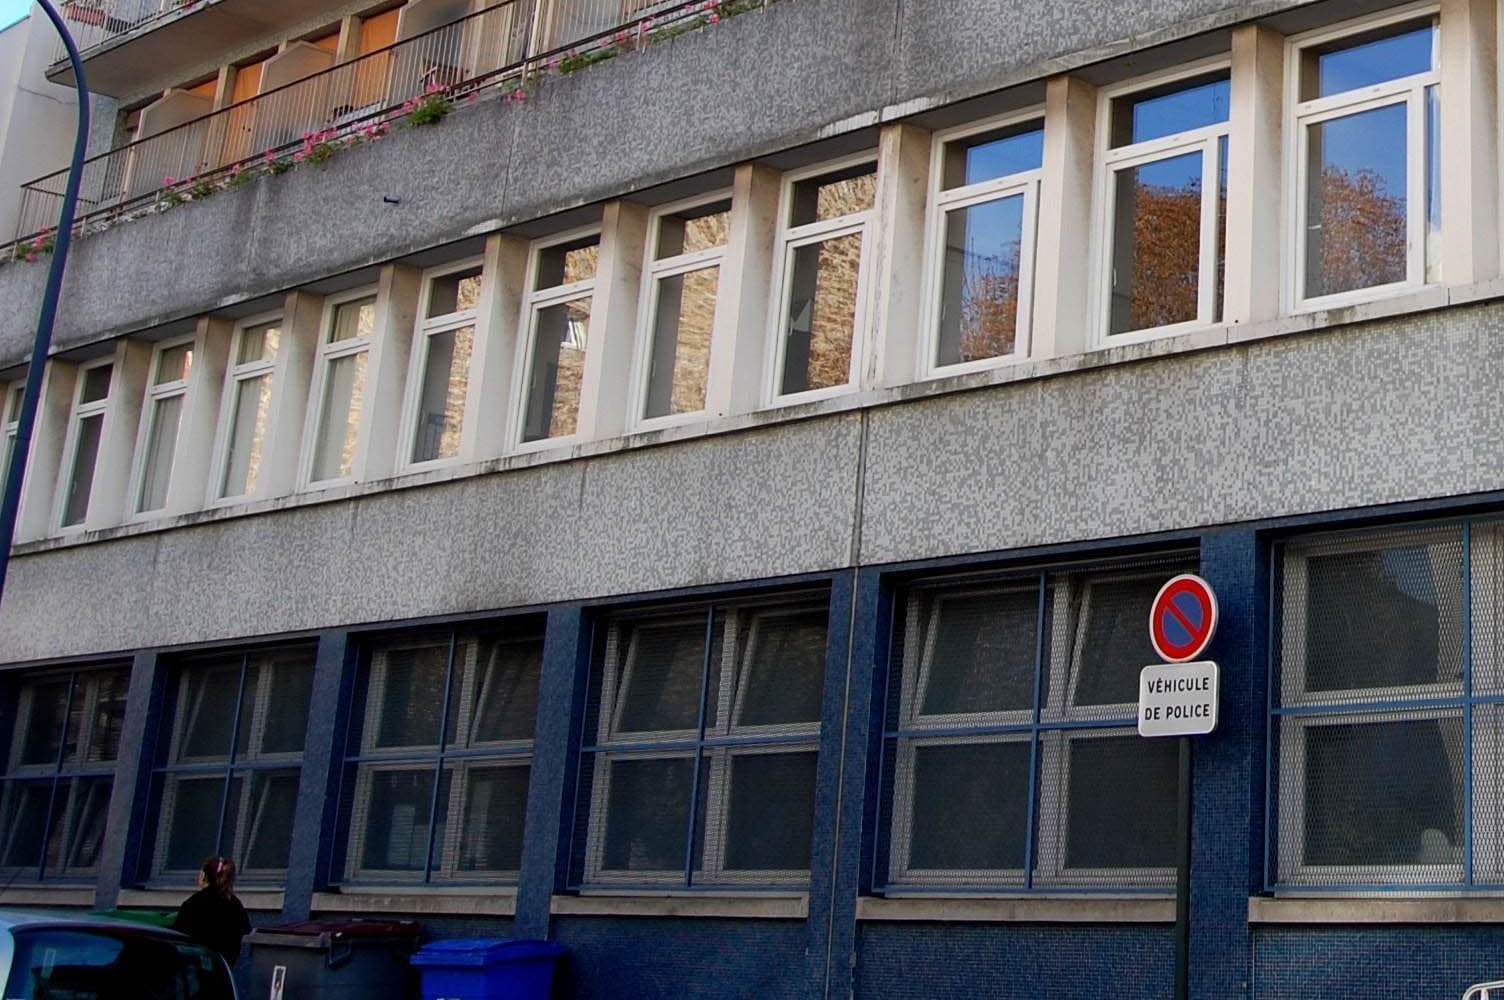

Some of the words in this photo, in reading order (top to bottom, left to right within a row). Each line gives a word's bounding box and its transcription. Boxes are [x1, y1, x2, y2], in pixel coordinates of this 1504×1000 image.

[1147, 677, 1209, 693] VÉHICULE
[1145, 707, 1161, 720] DE
[1166, 704, 1210, 720] POLICE
